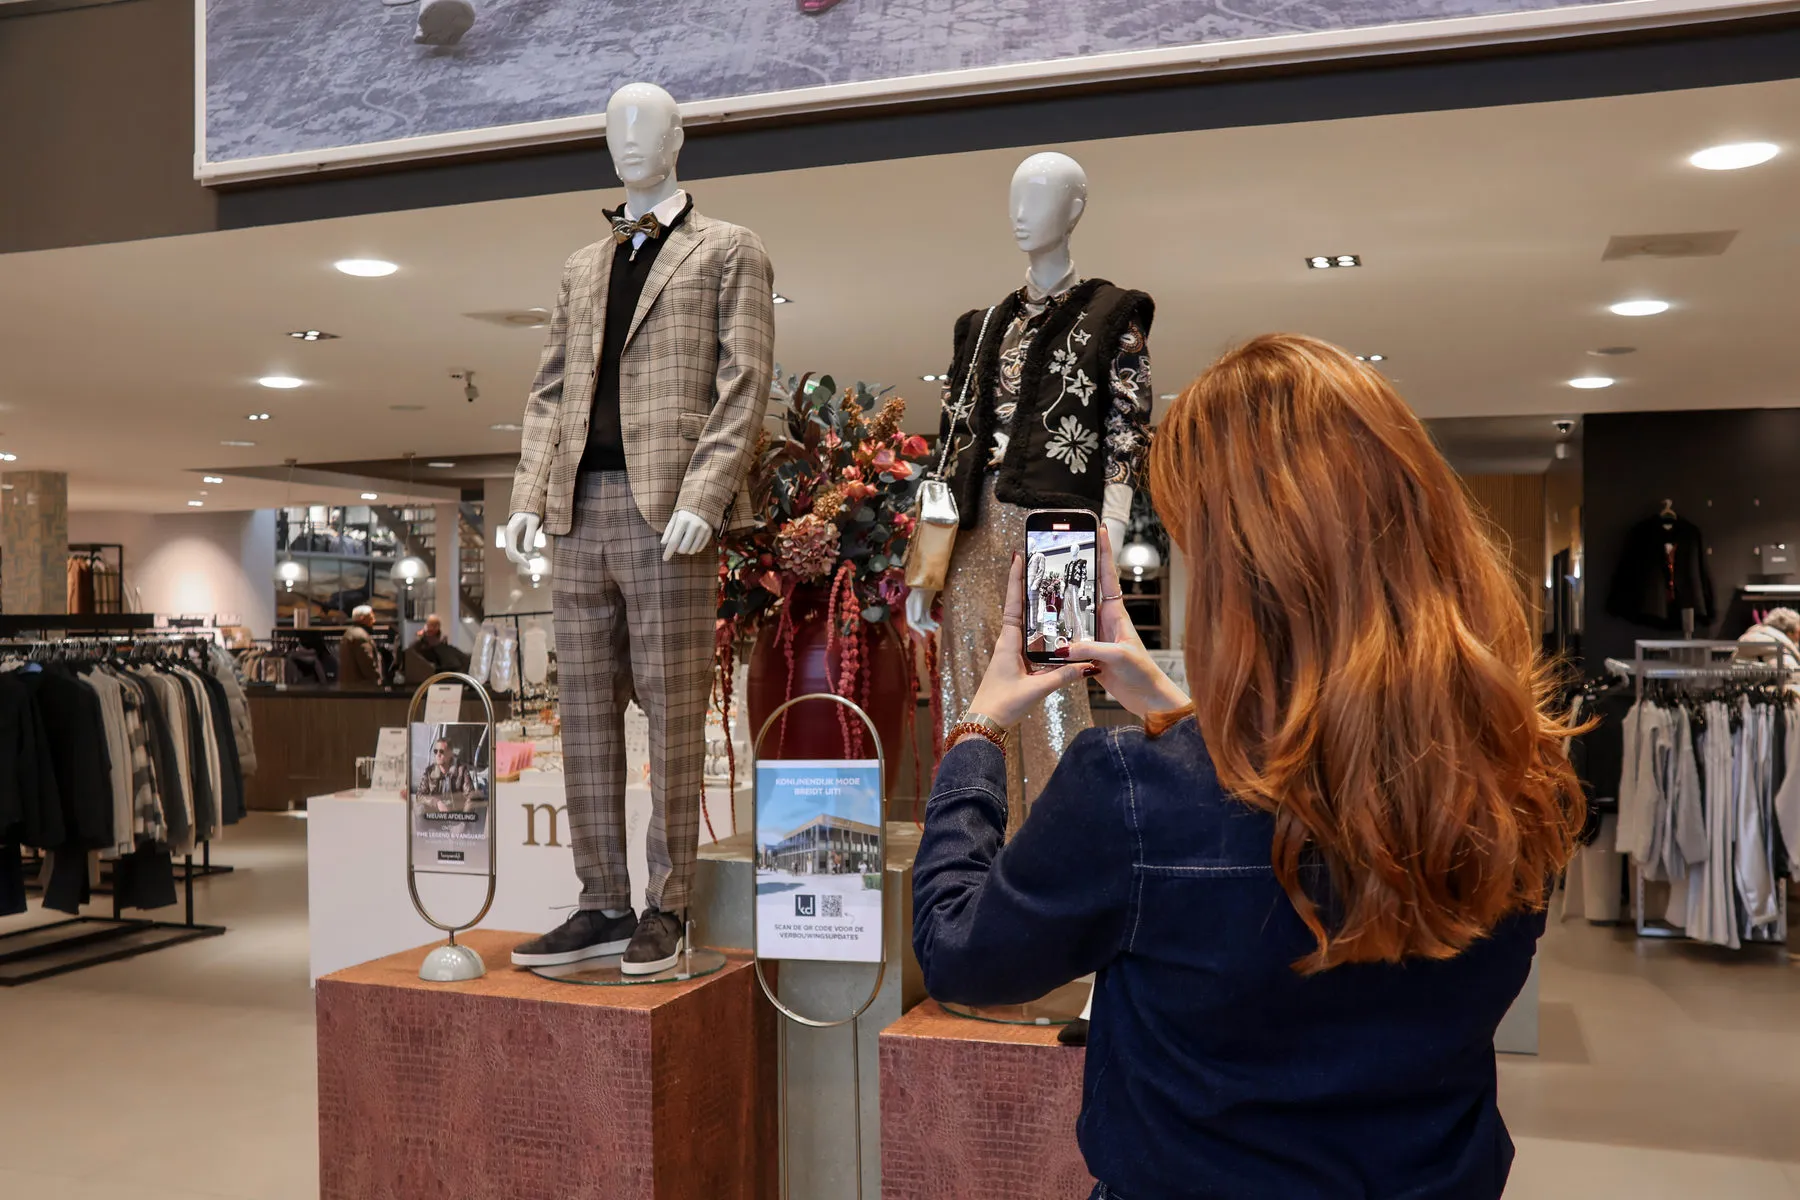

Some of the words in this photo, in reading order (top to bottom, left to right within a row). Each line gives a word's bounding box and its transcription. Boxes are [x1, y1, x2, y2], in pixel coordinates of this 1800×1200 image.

[835, 777, 860, 785] MODE
[426, 812, 447, 820] NIEUWE
[448, 813, 476, 821] AFDELING!
[456, 832, 486, 840] VANGUARD
[779, 932, 859, 940] VERBOUWINGSUPDATES
